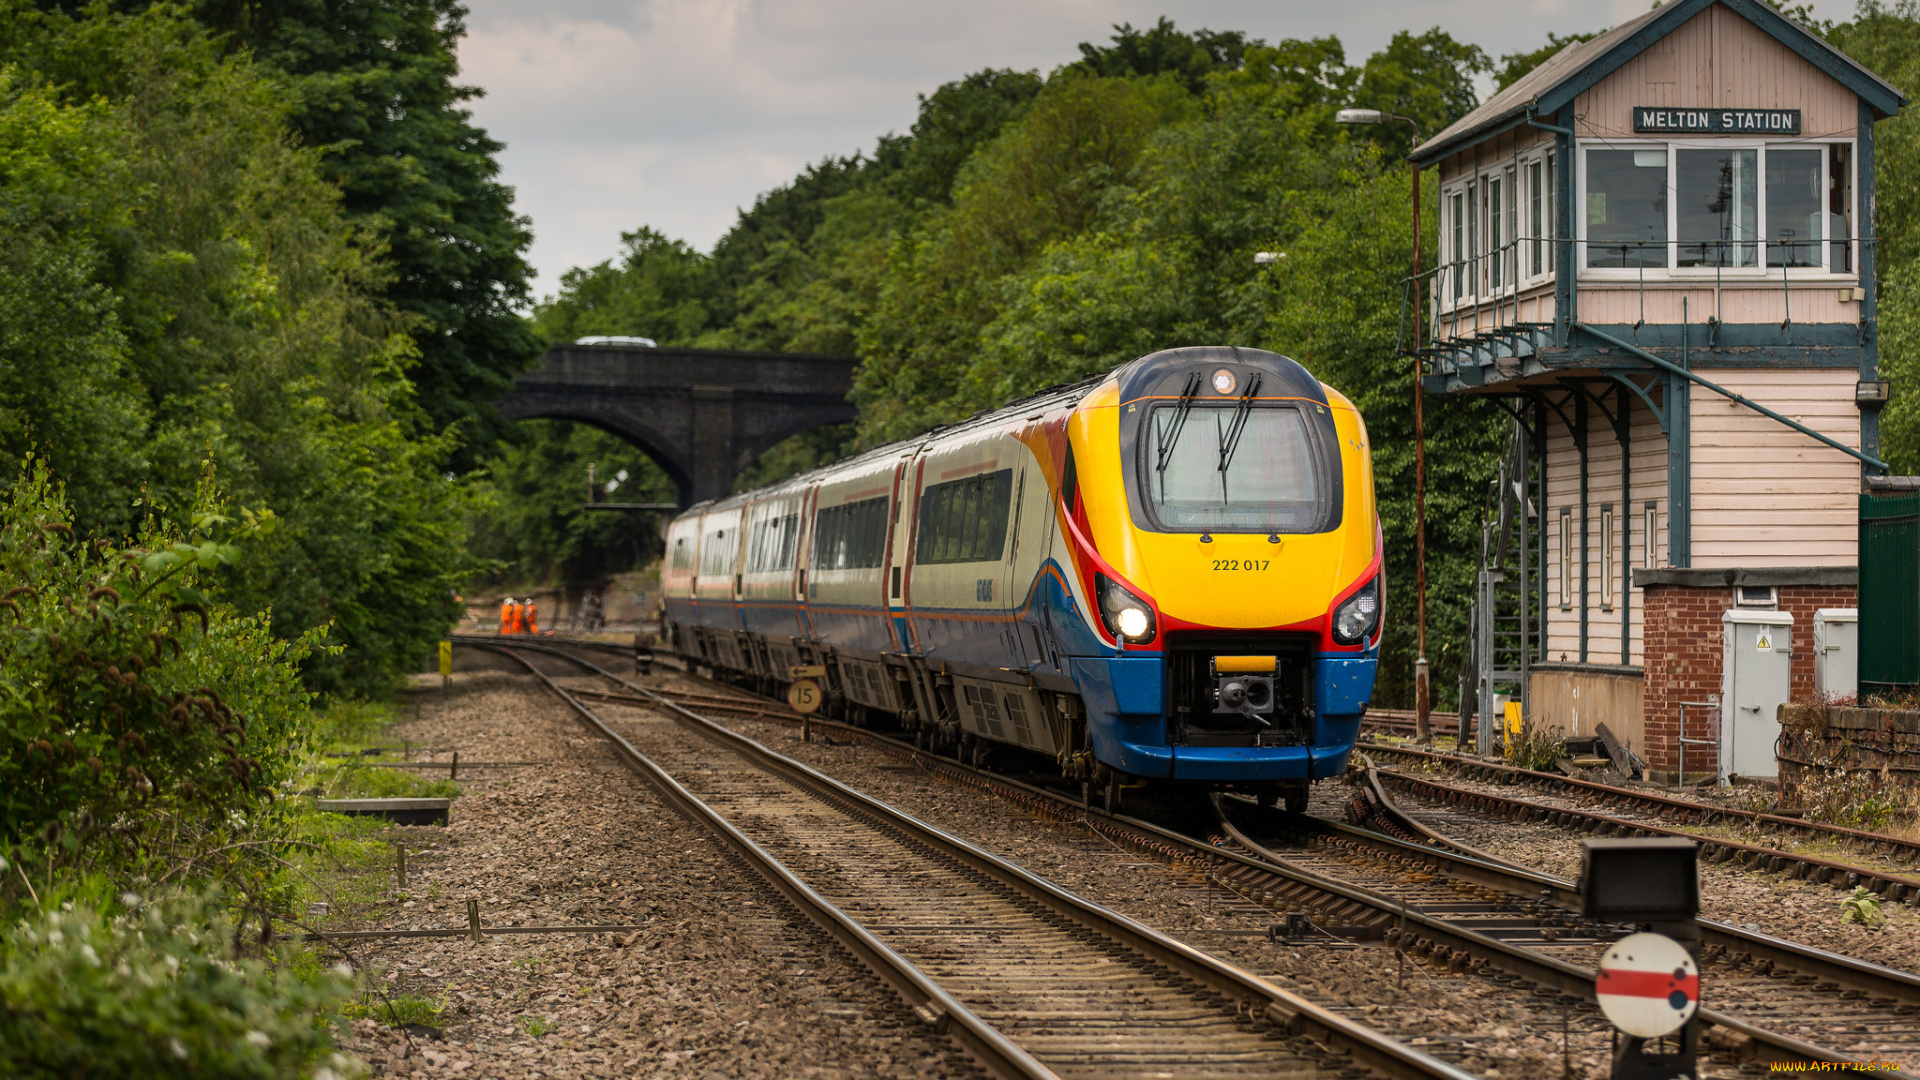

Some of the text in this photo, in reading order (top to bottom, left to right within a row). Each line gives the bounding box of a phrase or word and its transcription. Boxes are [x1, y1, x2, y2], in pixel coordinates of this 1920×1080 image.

[1643, 111, 1792, 129] MELTON STATION
[1212, 559, 1270, 571] 222 017
[797, 687, 813, 704] 15
